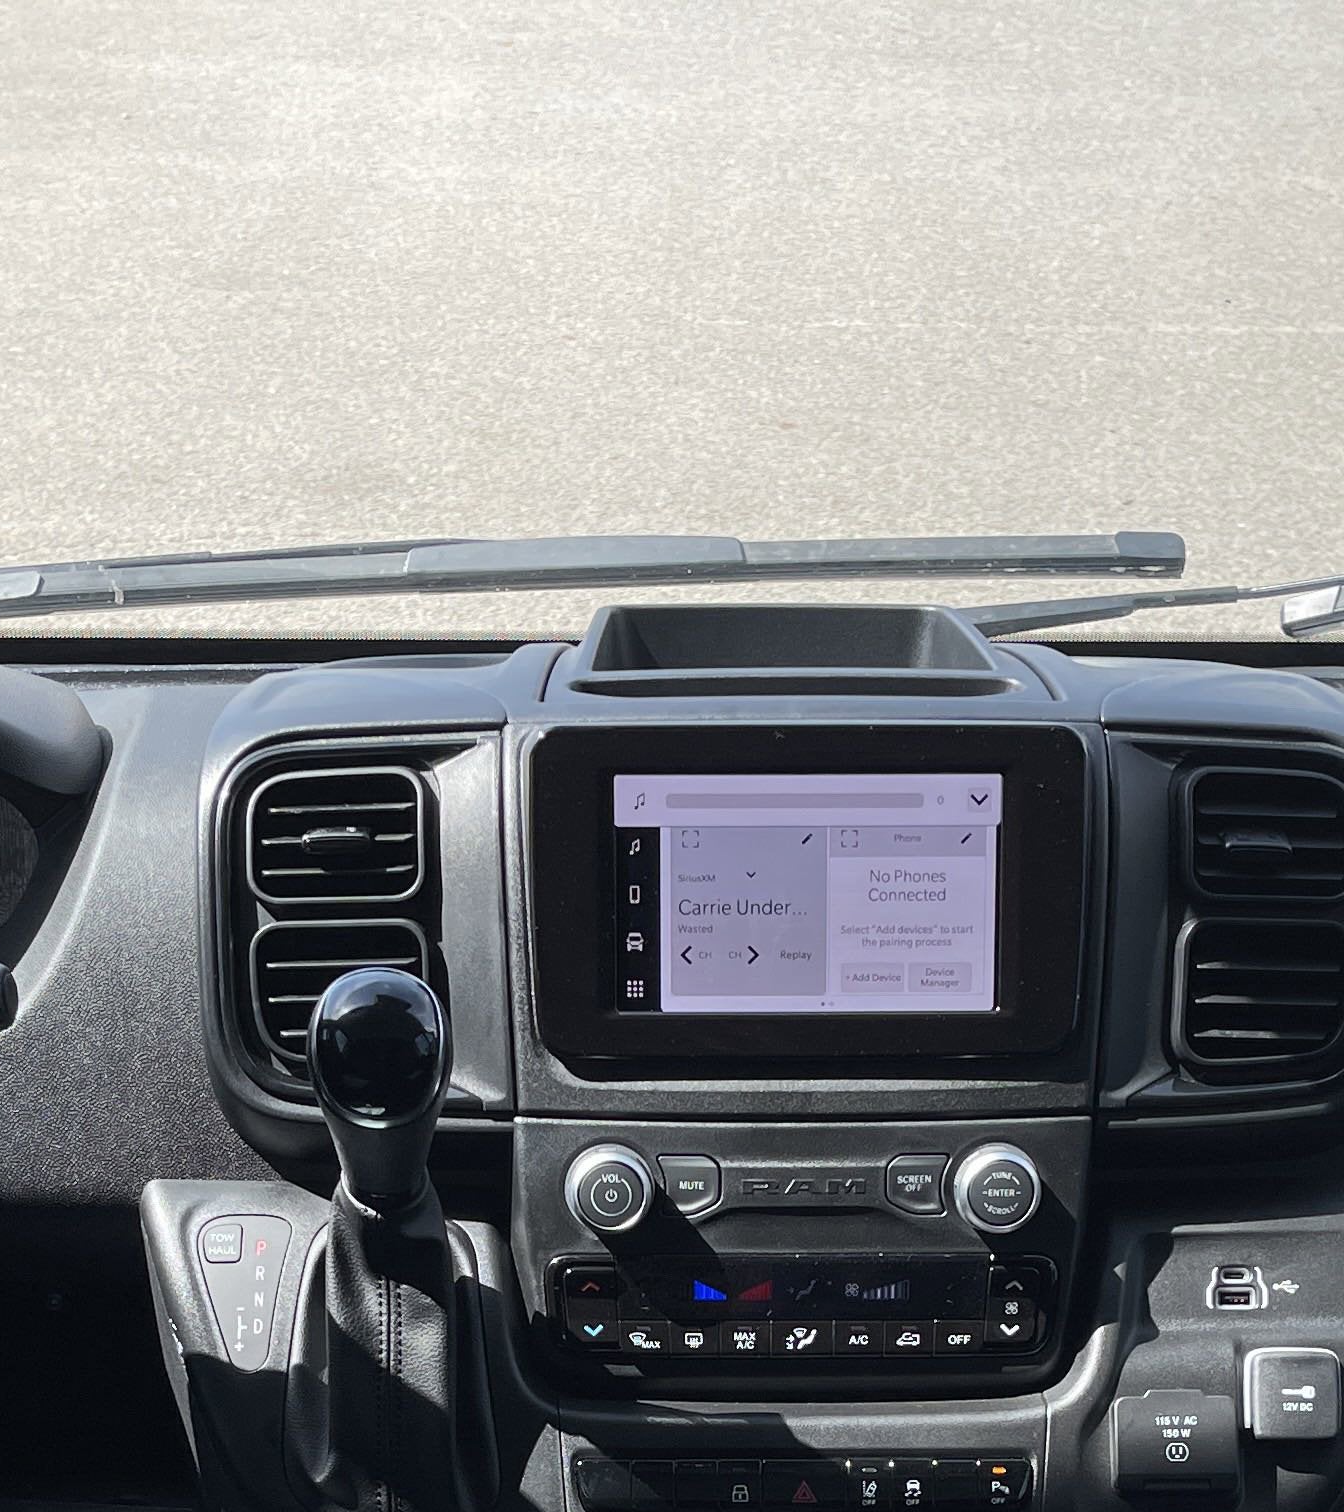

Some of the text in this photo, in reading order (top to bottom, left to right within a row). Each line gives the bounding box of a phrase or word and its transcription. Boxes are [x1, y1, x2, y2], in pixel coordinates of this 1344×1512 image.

[869, 869, 947, 883] No Phones
[868, 887, 947, 902] Connected
[678, 899, 732, 917] Carrie
[678, 924, 713, 935] Wasted
[840, 924, 868, 935] Select
[940, 925, 949, 935] to
[951, 925, 974, 935] start
[861, 937, 878, 948] the
[779, 950, 812, 963] Replay
[925, 967, 955, 977] Device
[851, 973, 902, 983] Add Device
[601, 1173, 621, 1184] VOL
[897, 1174, 932, 1185] SCREEN
[992, 1171, 1012, 1181] TUNE
[679, 1180, 705, 1191] MUTE
[741, 1178, 867, 1195] RAM
[905, 1183, 923, 1193] OFF
[988, 1188, 1016, 1198] ENTER
[987, 1203, 1015, 1216] SCROLL
[209, 1232, 235, 1243] TOW
[208, 1246, 237, 1256] HAUL
[256, 1240, 267, 1256] P
[256, 1265, 266, 1281] R
[254, 1291, 264, 1307] N
[253, 1318, 264, 1335] D
[733, 1331, 756, 1341] MAX
[848, 1334, 869, 1345] A/C
[948, 1334, 972, 1345] OFF
[641, 1340, 661, 1350] MAX
[736, 1340, 755, 1350] A/C
[1183, 1415, 1198, 1426] AC
[1180, 1428, 1191, 1438] W
